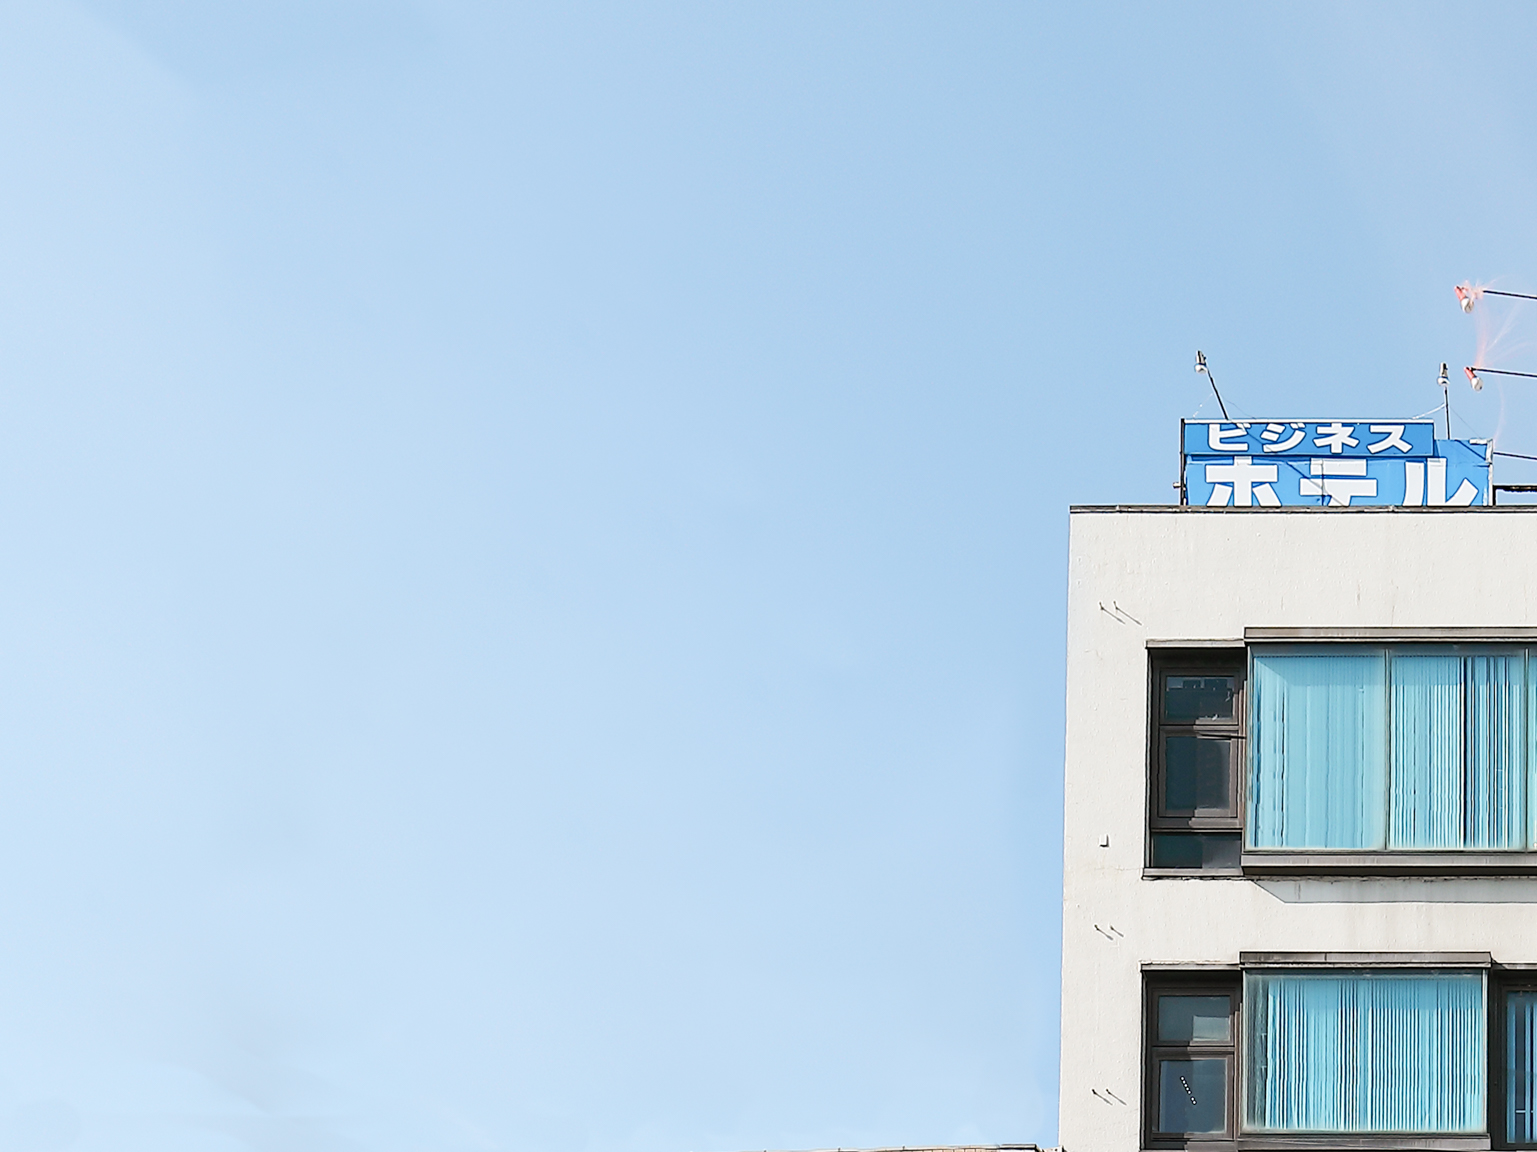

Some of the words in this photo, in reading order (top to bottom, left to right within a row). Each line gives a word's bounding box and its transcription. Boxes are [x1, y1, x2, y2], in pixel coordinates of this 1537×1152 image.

[1208, 422, 1414, 453] ビジネス
[1205, 456, 1479, 507] ホテル
